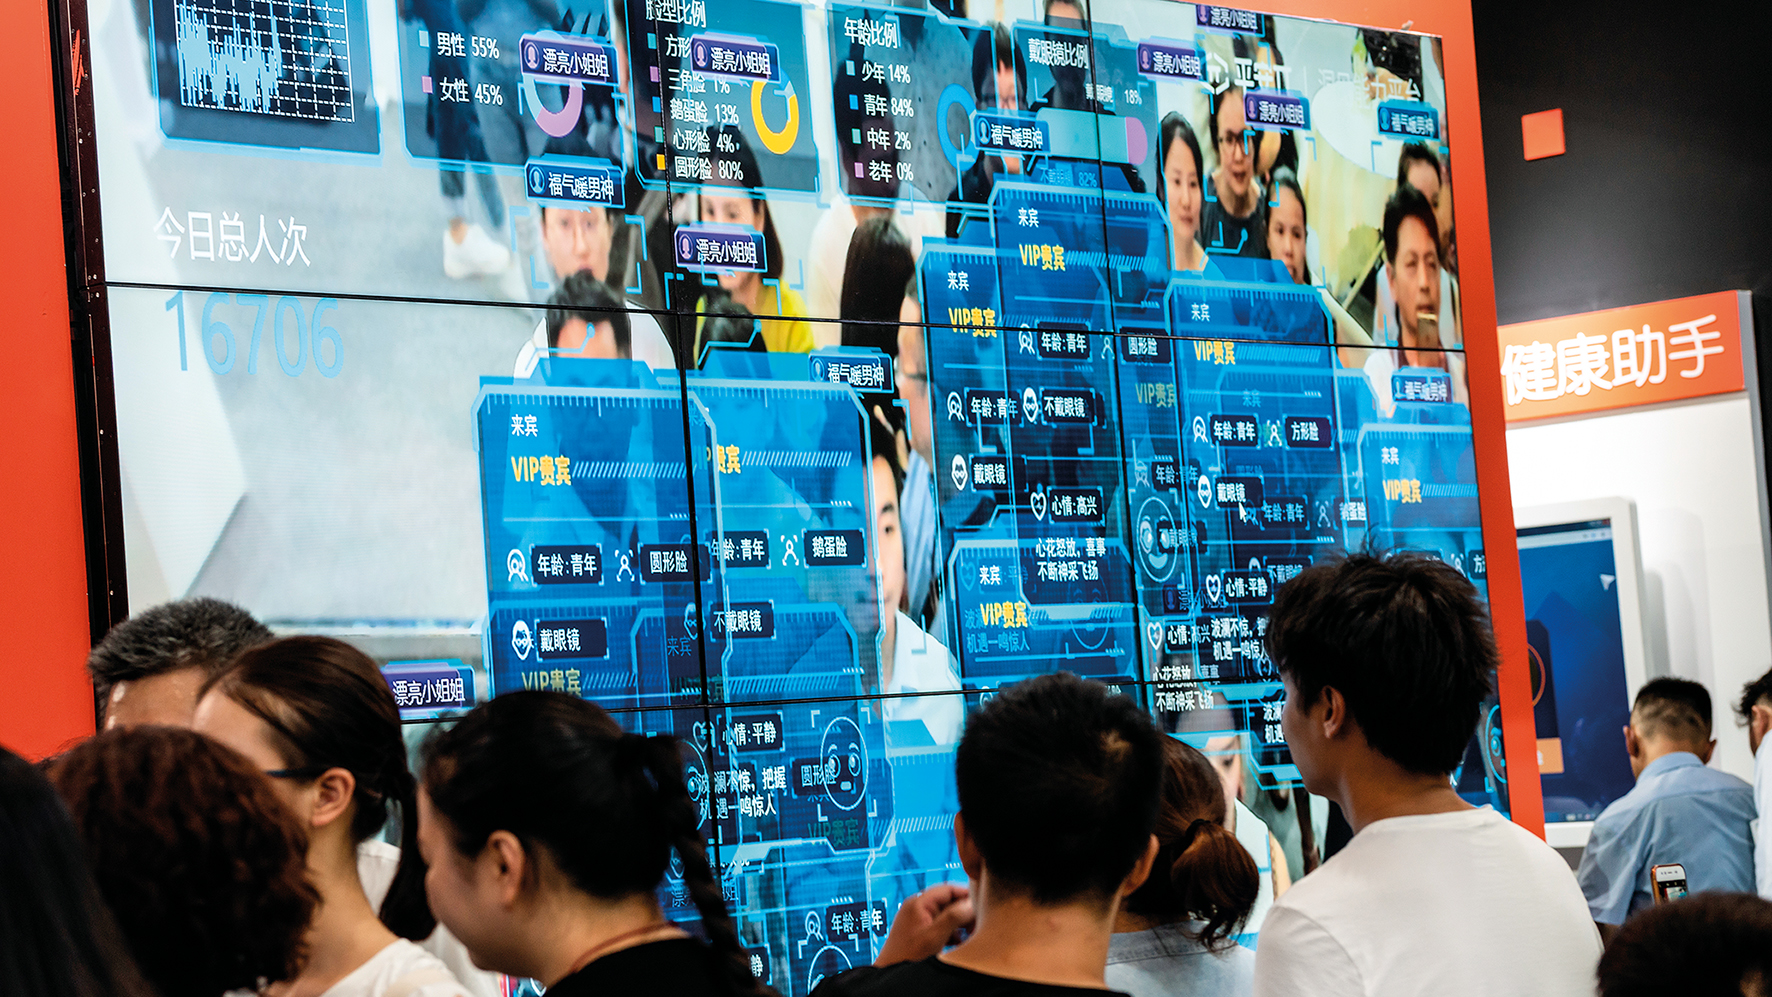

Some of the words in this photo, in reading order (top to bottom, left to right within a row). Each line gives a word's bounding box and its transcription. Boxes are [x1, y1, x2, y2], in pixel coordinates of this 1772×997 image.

[646, 0, 706, 28] 脸型比例
[437, 32, 466, 57] 男性
[472, 36, 500, 59] 55%
[844, 17, 898, 49] 年龄比例
[543, 48, 610, 78] 漂亮小姐姐
[711, 47, 772, 75] 漂亮小姐姐
[1028, 38, 1089, 69] 戴眼镜比例
[1153, 51, 1201, 76] 漂亮小姐姐
[668, 68, 706, 93] 三角脸
[713, 76, 730, 94] 1%
[862, 61, 885, 84] 少年
[888, 64, 911, 84] 14%
[440, 77, 469, 103] 女性
[475, 84, 503, 106] 45%
[1124, 89, 1143, 106] 18%
[670, 98, 708, 123] 鹅蛋脸
[714, 104, 739, 124] 13%
[864, 94, 887, 117] 青年
[891, 98, 914, 118] 84%
[1259, 100, 1305, 126] 漂亮小姐姐
[673, 128, 710, 153] 心形脸
[717, 134, 735, 153] 4%
[867, 127, 890, 150] 中年
[895, 131, 911, 150] 2%
[991, 124, 1044, 151] 福气暖男神
[674, 156, 712, 180] 圆形脸
[718, 160, 744, 180] 80%
[869, 160, 892, 183] 老年
[897, 163, 914, 181] 0%
[1078, 172, 1098, 188] 82%
[549, 172, 614, 200] 福气暖男神
[1018, 207, 1039, 228] 来宾
[153, 207, 311, 267] 今日总人次
[696, 238, 759, 264] 漂亮小姐姐
[1019, 243, 1066, 272] VIP贵宾
[947, 270, 969, 291] 来宾
[948, 306, 997, 338] VIP贵宾
[1191, 303, 1210, 322] 来宾
[165, 290, 344, 379] 16706
[1128, 332, 1158, 356] 圆形脸
[1193, 338, 1236, 365] VIP贵宾
[1501, 314, 1725, 406] 健康助手
[828, 363, 884, 387] 福气暖男神
[1044, 396, 1086, 418] 不戴眼镜
[1135, 383, 1176, 408] VIP贵宾
[511, 414, 538, 437] 来宾
[1291, 420, 1319, 441] 方形脸
[1381, 446, 1399, 465] 来宾
[511, 454, 572, 486] VIP贵宾
[974, 463, 1007, 484] 戴眼镜
[1217, 482, 1247, 504] 戴眼镜
[1382, 478, 1422, 503] VIP贵宾
[812, 536, 848, 558] 鹅蛋脸
[650, 550, 688, 574] 圆形脸
[979, 564, 1001, 585] 来宾
[1037, 561, 1099, 582] 不断神采飞扬
[713, 609, 763, 633] 不戴眼镜
[980, 600, 1028, 629] VIP贵宾
[540, 628, 581, 652] 戴眼镜
[667, 635, 692, 657] 来宾
[393, 677, 466, 706] 漂亮小姐姐
[521, 667, 582, 698] VIP贵宾
[1155, 690, 1214, 712] 不断神采飞扬
